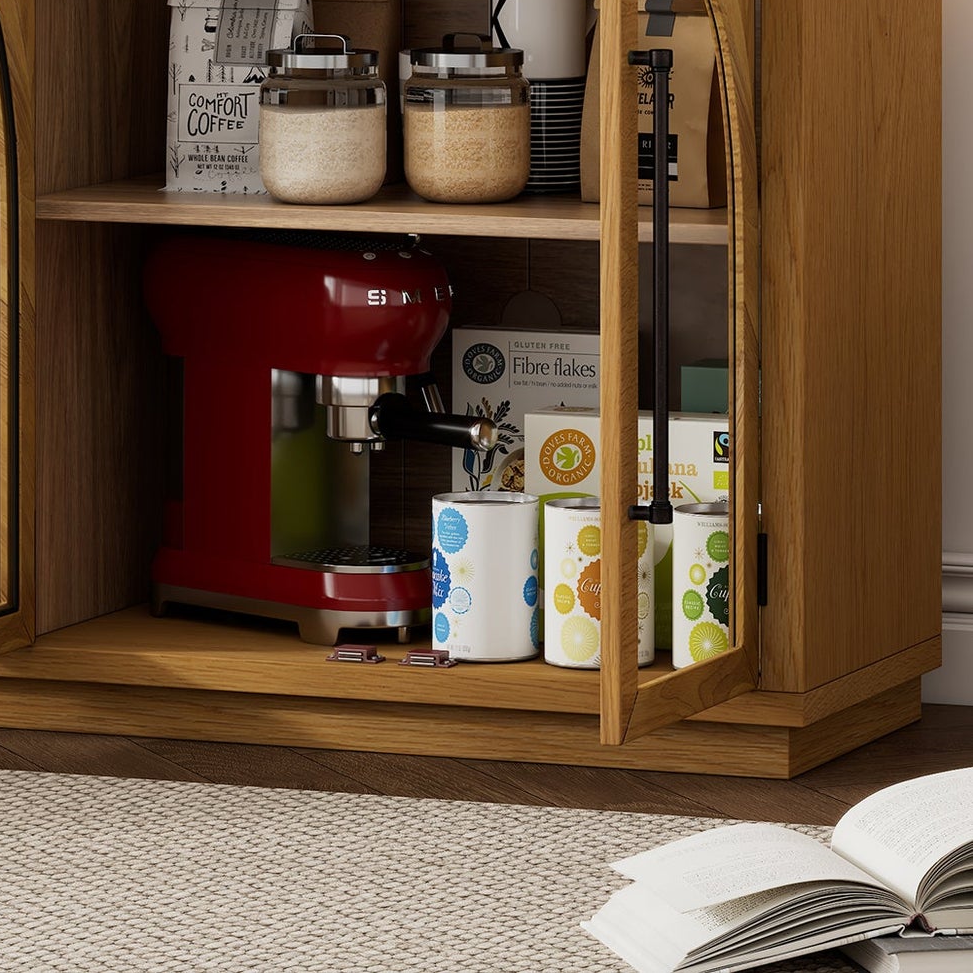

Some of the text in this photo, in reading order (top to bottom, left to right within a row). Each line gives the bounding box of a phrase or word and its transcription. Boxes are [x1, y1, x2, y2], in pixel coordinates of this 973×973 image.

[189, 92, 256, 119] COMFORT
[188, 108, 244, 136] COFFEE
[227, 155, 248, 163] COFFEE
[465, 346, 486, 366] DOVES
[514, 341, 570, 351] GLUTEN FREE
[467, 368, 502, 382] ORGANIC
[513, 356, 596, 378] Fibre flakes
[542, 432, 592, 464] DOVES FARM
[548, 459, 592, 482] ORGANIC
